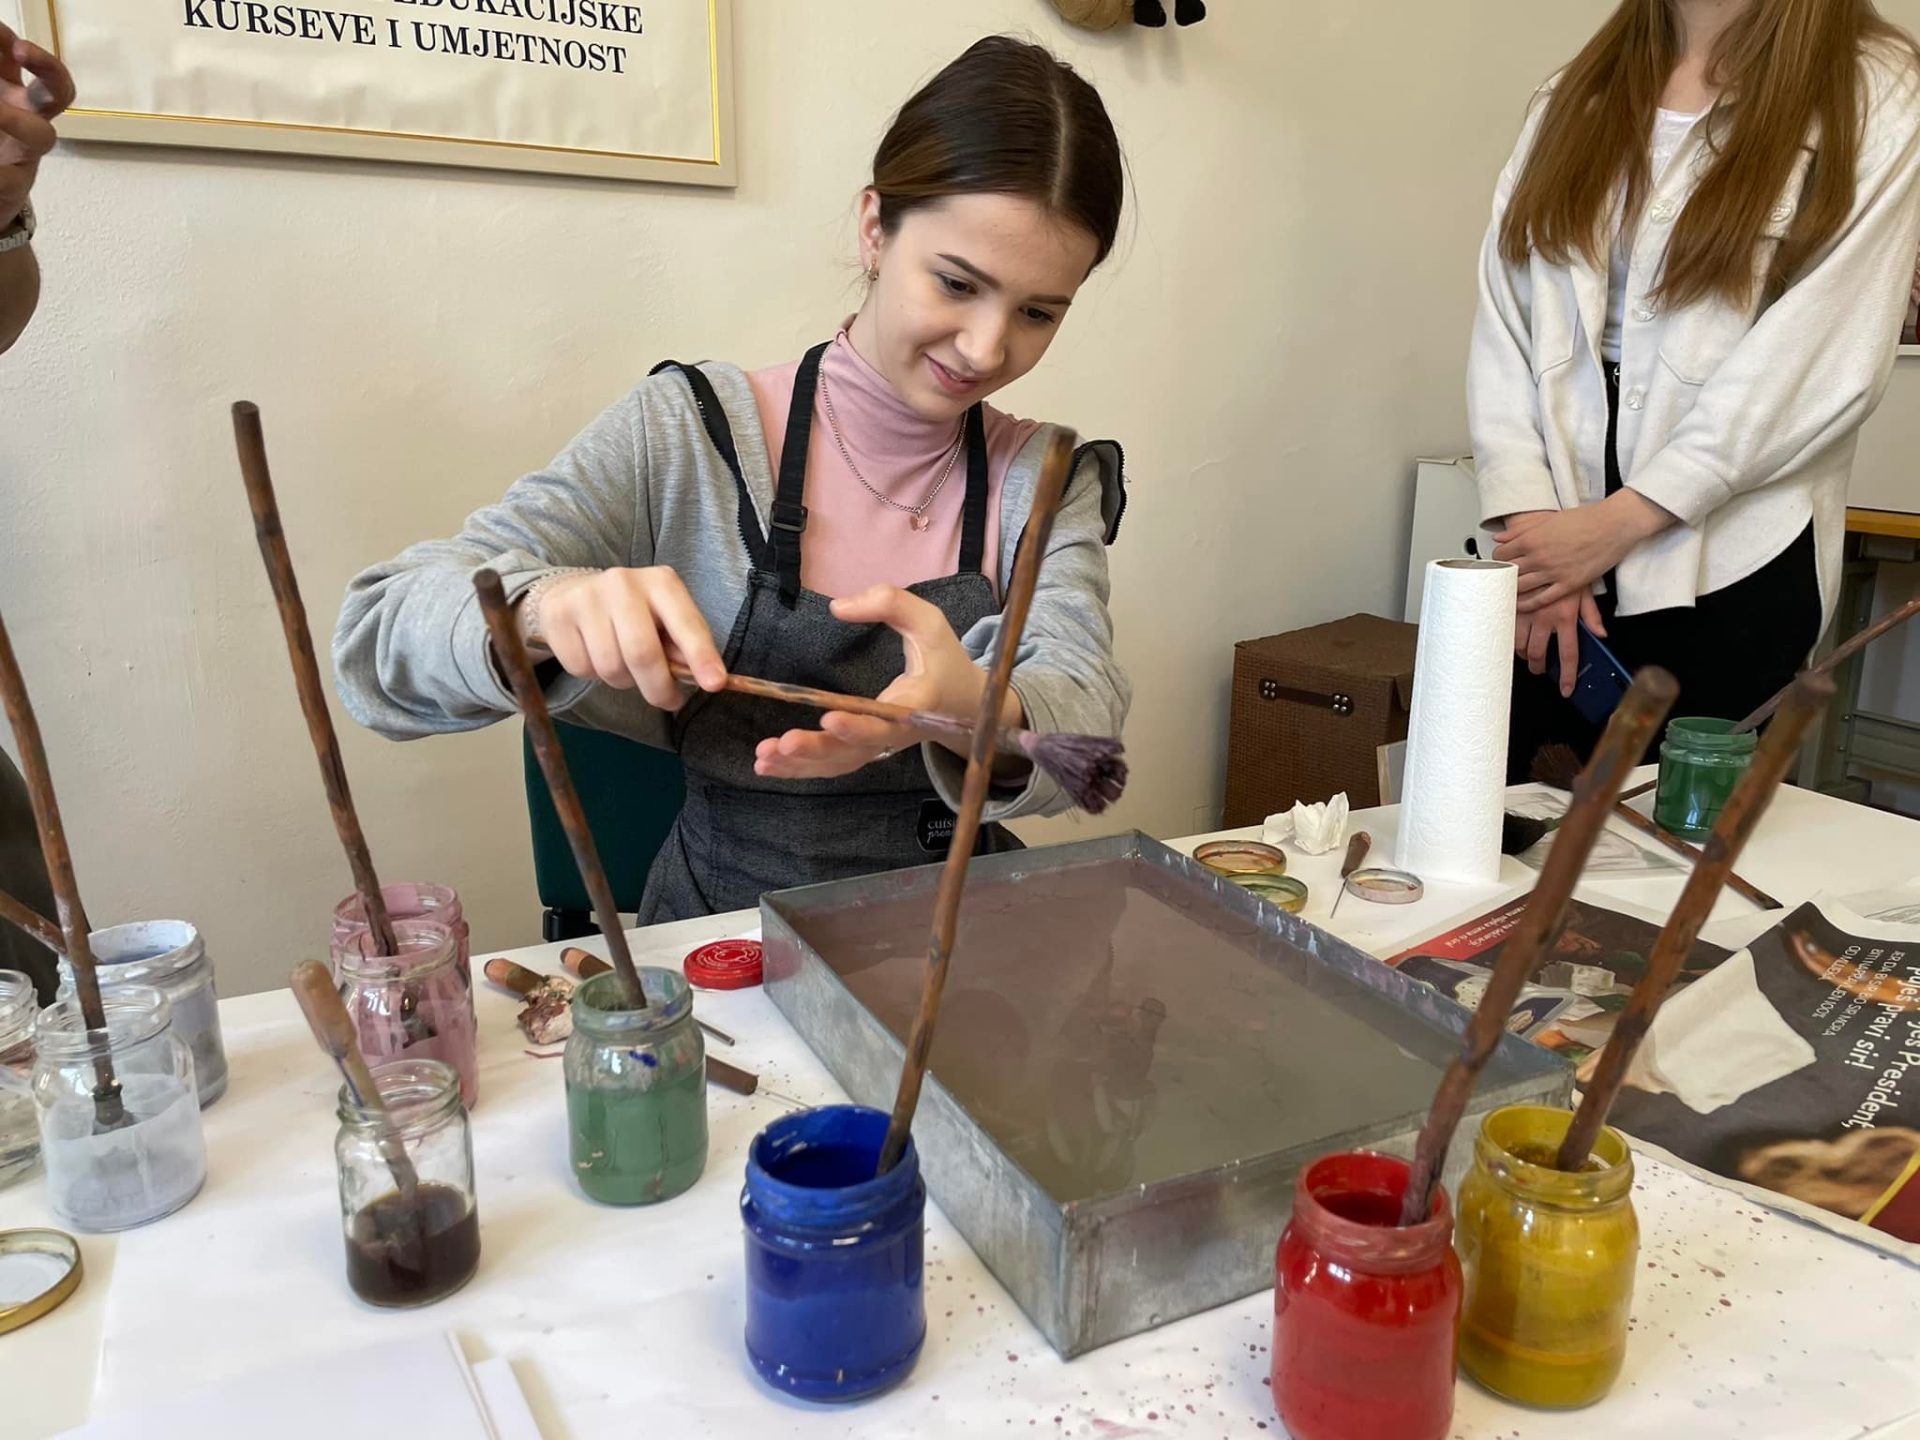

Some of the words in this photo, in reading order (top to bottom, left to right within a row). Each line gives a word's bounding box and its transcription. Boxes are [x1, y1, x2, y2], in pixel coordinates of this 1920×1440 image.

[393, 0, 644, 34] ACIJSKE
[183, 0, 376, 46] KURSEVE
[386, 18, 402, 48] I
[410, 20, 627, 74] UMJETNOST
[1844, 945, 1861, 956] OD
[1878, 961, 1897, 972] DA
[1821, 1013, 1851, 1036] MORA
[1864, 1002, 1906, 1040] pravi
[1844, 1039, 1879, 1070] sir!
[1841, 1051, 1920, 1128] President,
